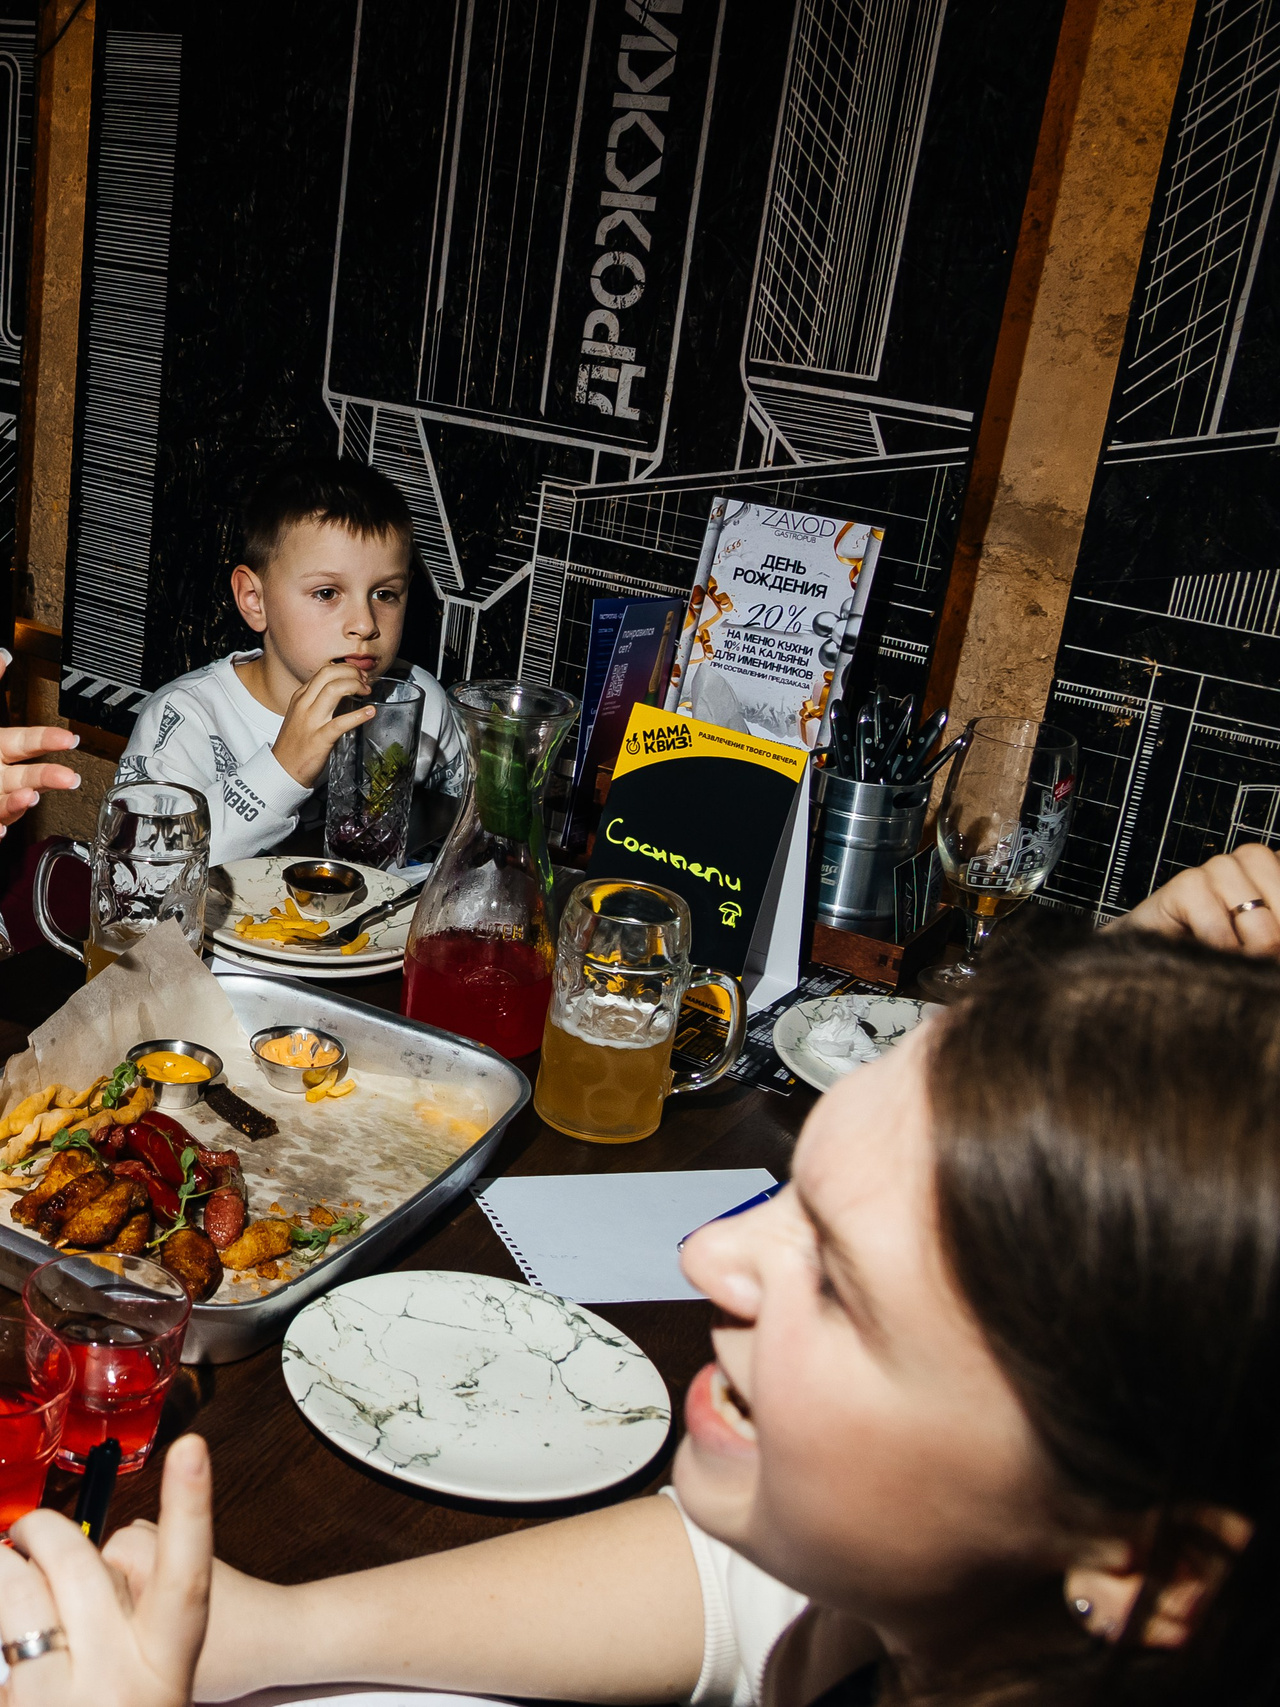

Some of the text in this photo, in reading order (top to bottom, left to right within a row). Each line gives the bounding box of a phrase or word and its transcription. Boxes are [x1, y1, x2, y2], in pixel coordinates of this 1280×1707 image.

[761, 507, 837, 538] ZAVOD
[774, 529, 818, 544] GASTROPUB
[760, 554, 807, 575] ДЕНЬ
[732, 567, 828, 600] РОЖДЕНИЯ
[743, 603, 807, 635] 20%
[723, 639, 810, 668] 10% НА КАЛЬЯНЫ
[726, 628, 814, 657] НА МЕНЮ КУХНИ
[710, 661, 811, 691] ПРИ СОСТАВЛЕНИИ ПРЕДЗАКАЗА
[713, 650, 814, 680] ДЛЯ ИМЕНИННИКОВ
[642, 723, 691, 743] МАМА
[644, 736, 693, 754] КВИЗ!
[698, 731, 745, 751] РАЗВЛЕЧЕНИЕ
[745, 745, 771, 758] ТВОЕГО
[772, 753, 797, 767] ВЕЧЕРА
